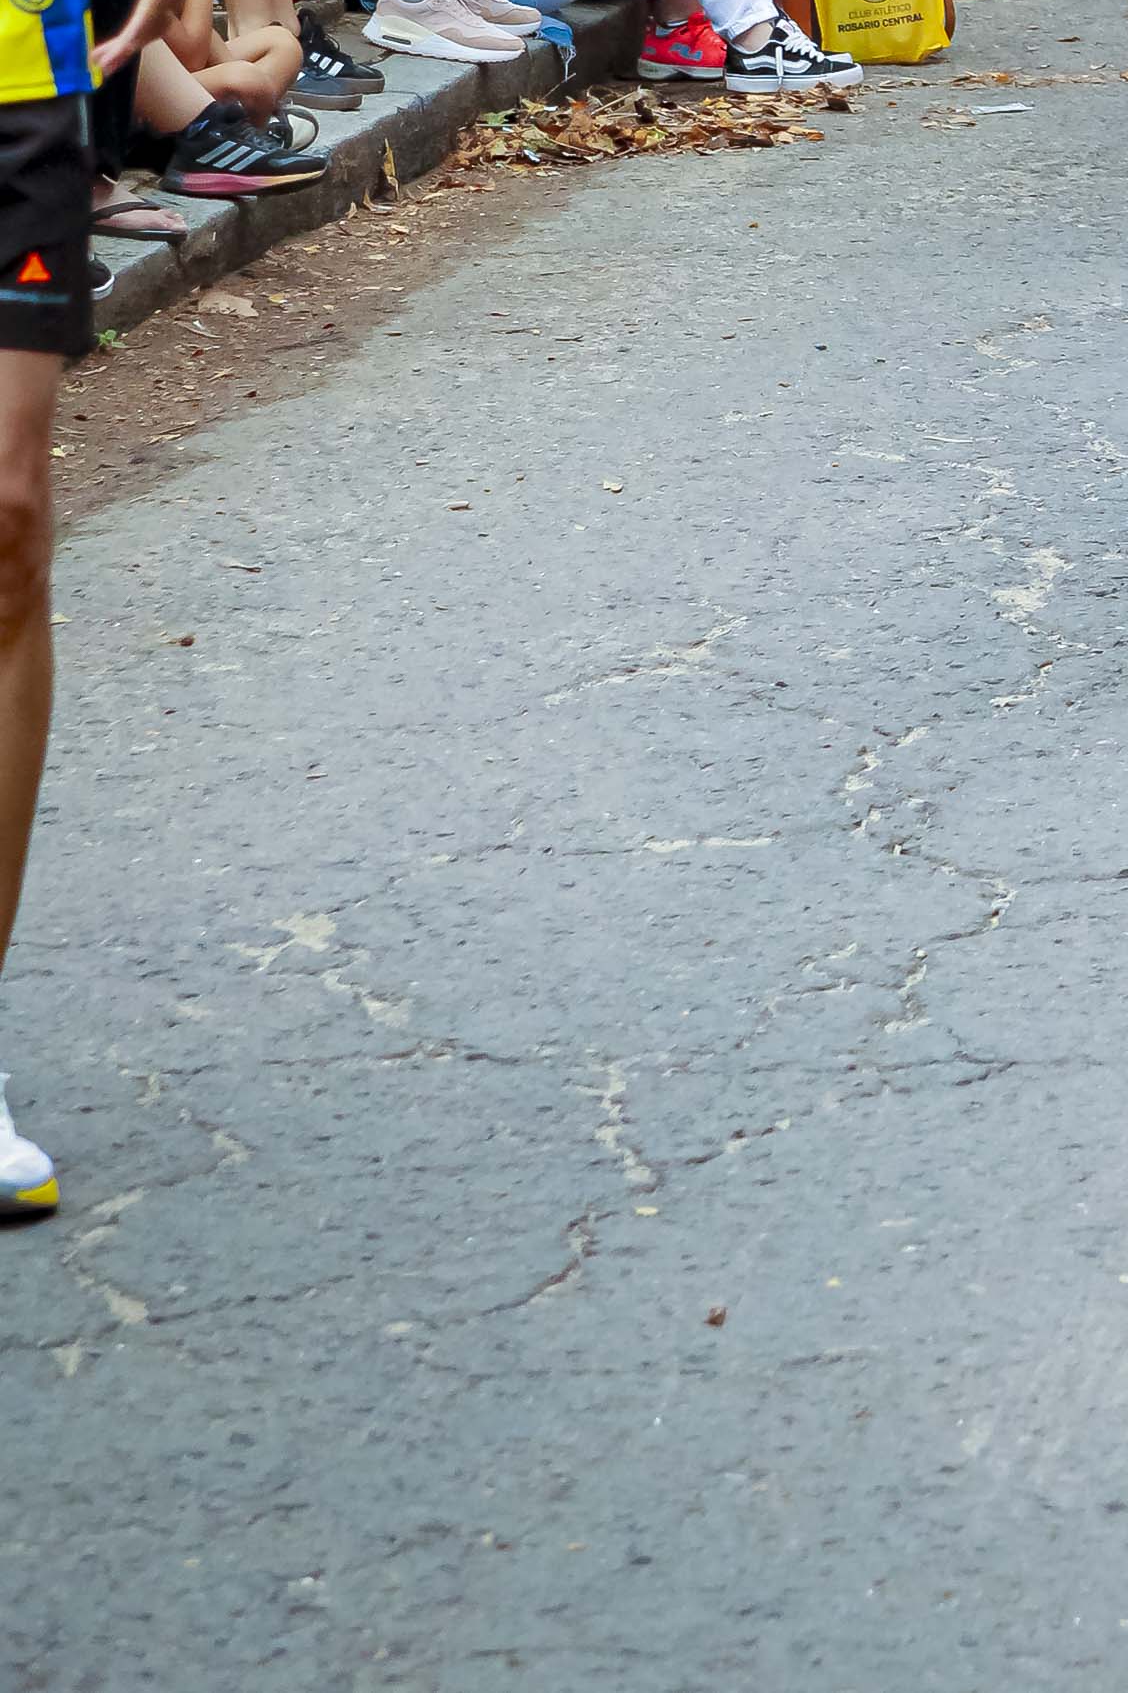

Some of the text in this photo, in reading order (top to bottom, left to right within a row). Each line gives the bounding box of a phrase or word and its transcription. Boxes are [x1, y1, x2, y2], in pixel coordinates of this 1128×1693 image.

[848, 3, 912, 20] CLUB ATLÉTICO
[837, 12, 924, 33] ROSARIO CENTRAL
